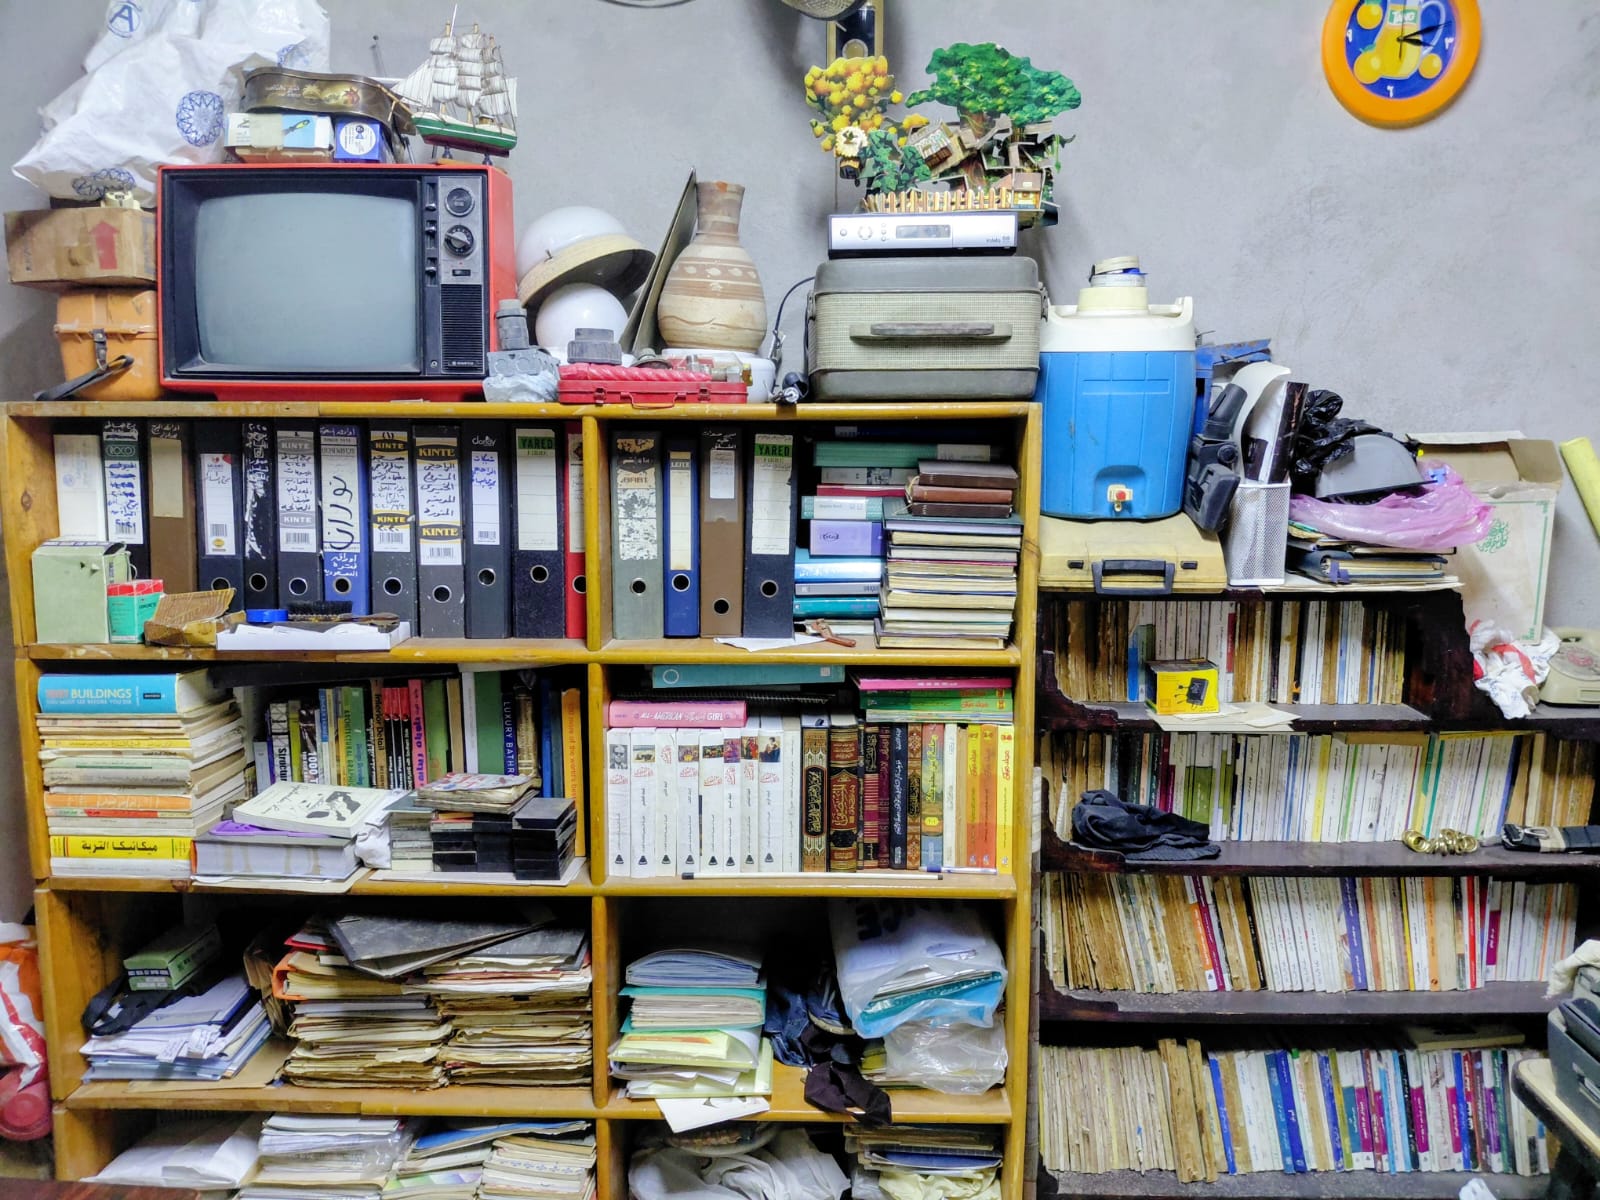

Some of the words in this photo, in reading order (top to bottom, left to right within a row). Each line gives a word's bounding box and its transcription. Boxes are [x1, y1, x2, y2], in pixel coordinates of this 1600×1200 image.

[376, 442, 404, 450] KINTE
[419, 448, 455, 457] KINTE
[422, 527, 459, 536] KINTE
[71, 687, 132, 699] BUILDINGS
[374, 693, 383, 727] Interior
[504, 701, 513, 738] LUXURY
[707, 712, 724, 721] GIRL
[376, 727, 385, 750] Detail
[308, 751, 318, 775] 1000
